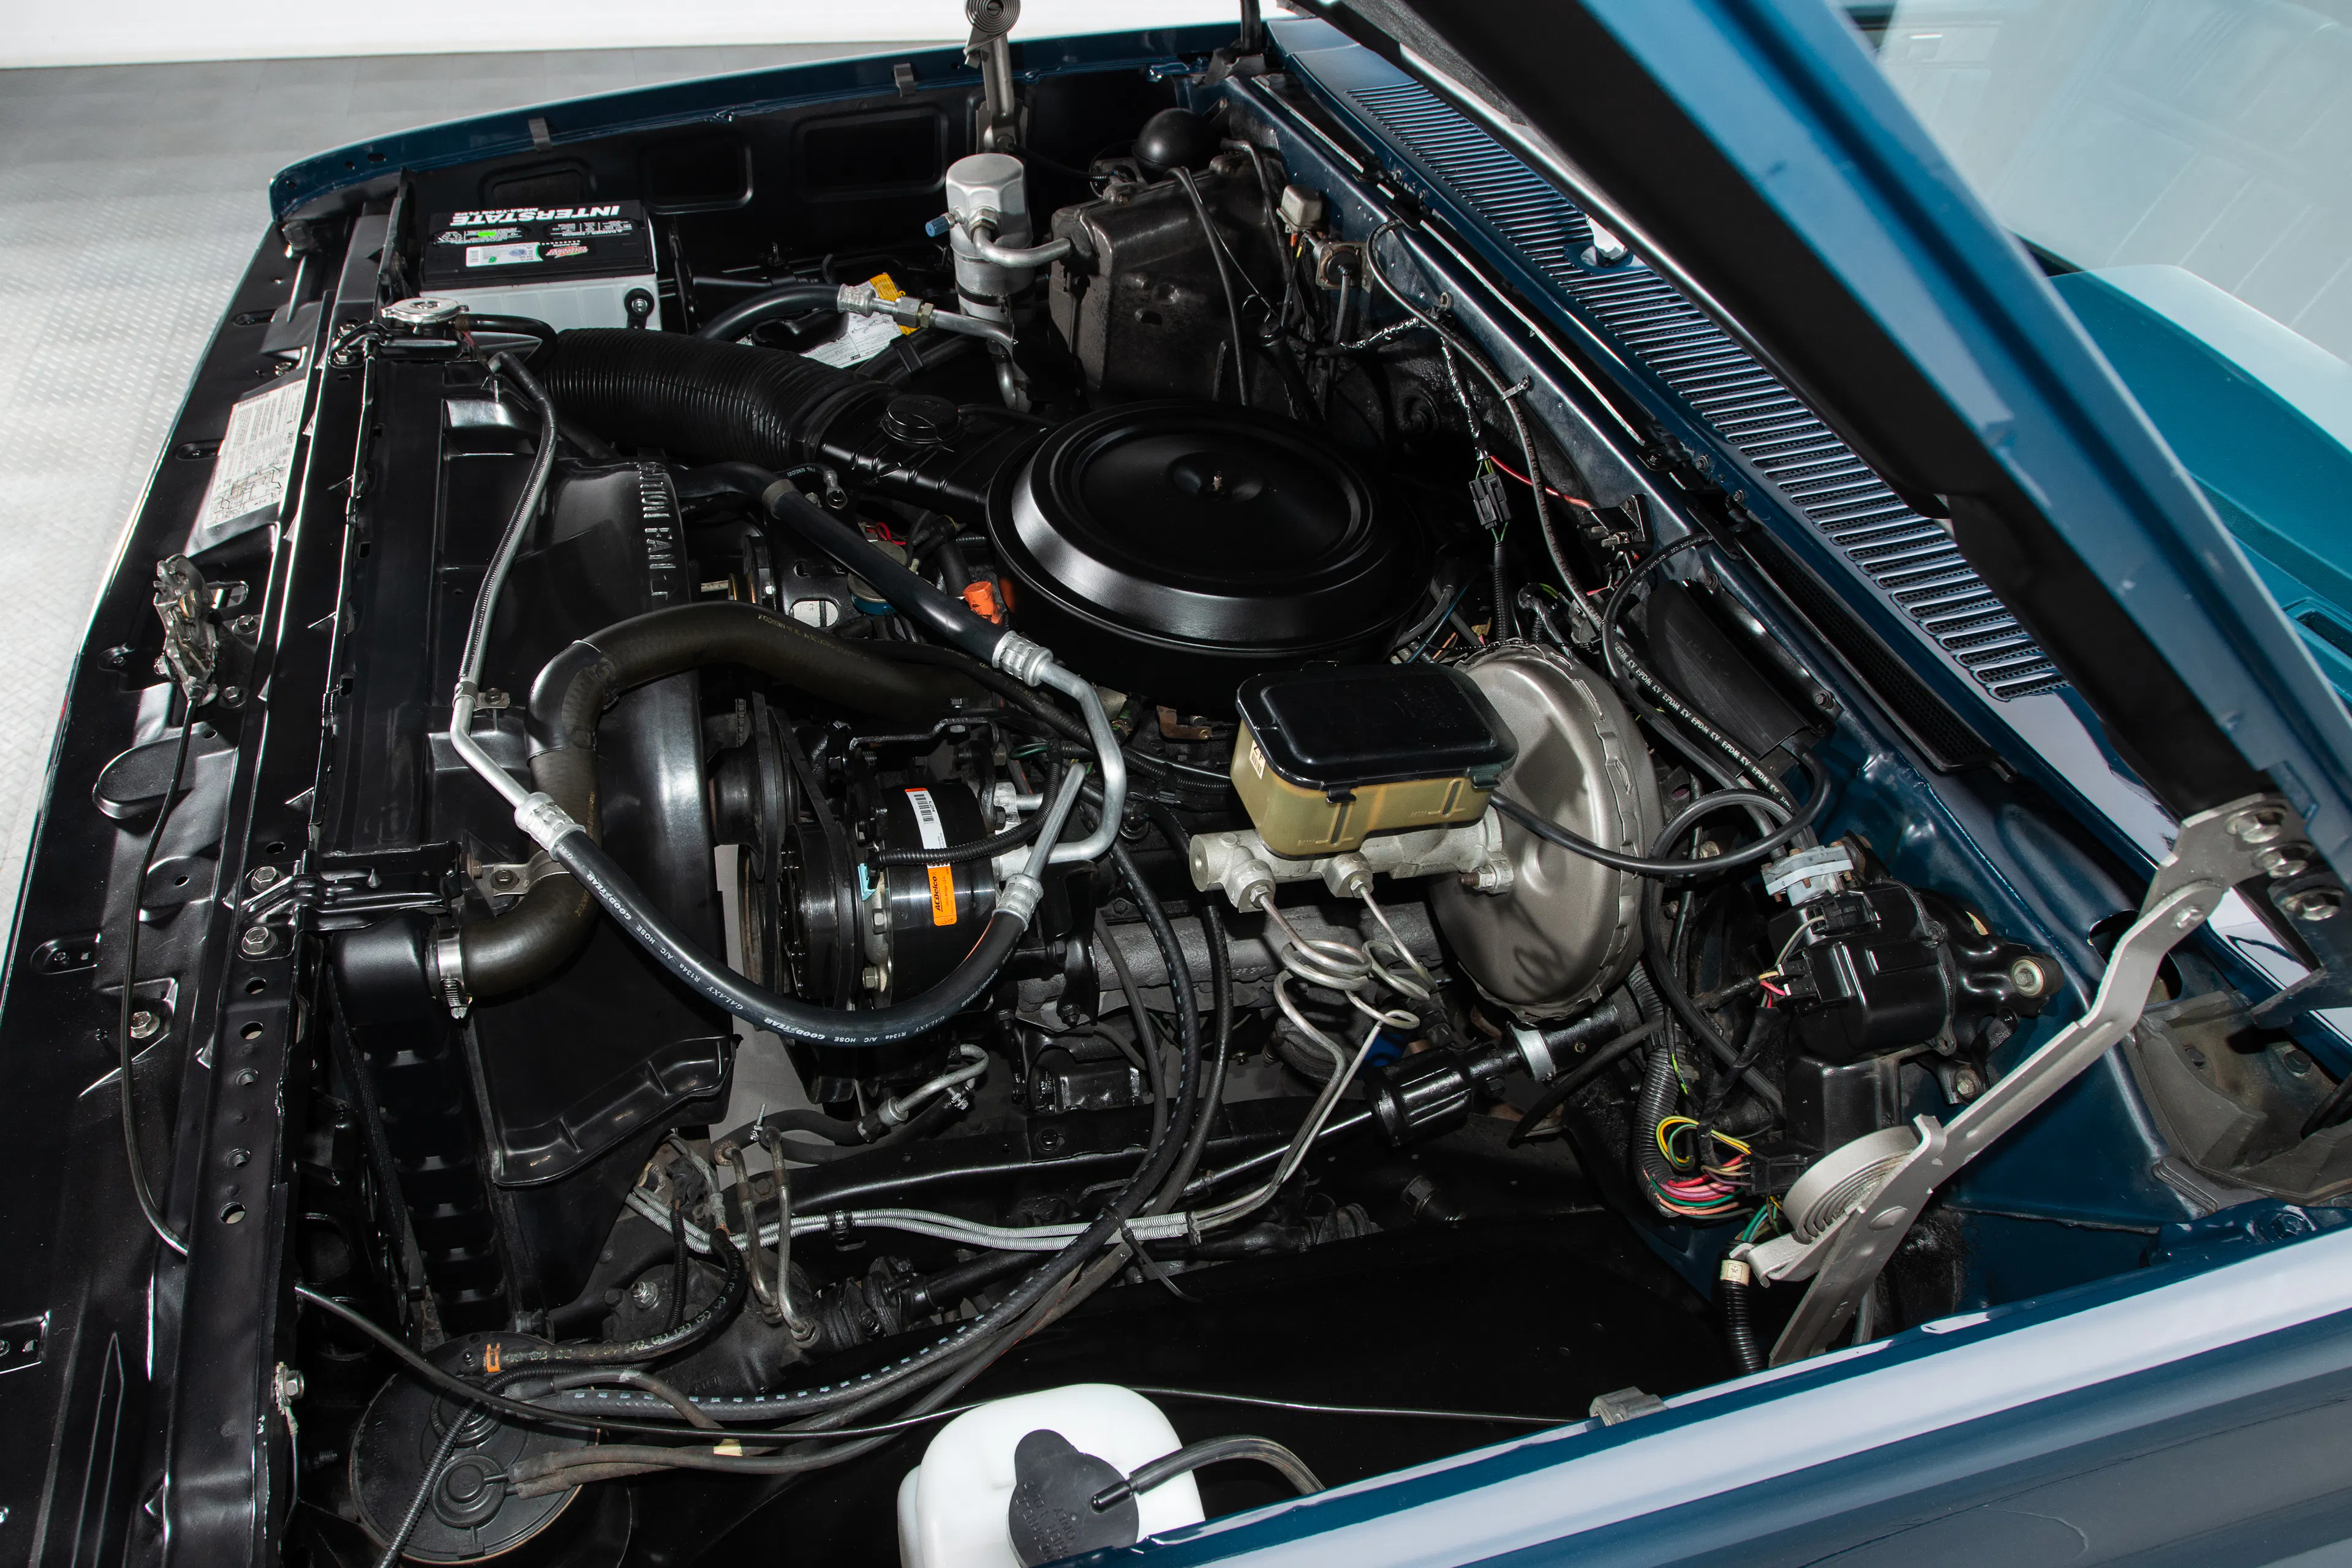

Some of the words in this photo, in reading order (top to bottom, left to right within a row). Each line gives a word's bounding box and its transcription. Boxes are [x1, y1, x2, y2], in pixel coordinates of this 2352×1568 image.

[450, 205, 620, 226] INTERSTATE
[644, 527, 676, 569] FAN
[1615, 642, 1629, 659] EPDM
[1627, 659, 1638, 669] KV
[1635, 668, 1653, 686] EPDM
[1652, 685, 1662, 694] KV
[1662, 693, 1680, 710] EPDM
[1681, 708, 1692, 718] KV
[1691, 717, 1710, 734] EPDM
[1709, 731, 1721, 742] KV
[1721, 741, 1741, 760] EPDM
[1740, 756, 1751, 766] KV
[1751, 766, 1771, 786] EPDM
[1769, 783, 1780, 796] KV
[586, 873, 632, 921] GOODYEAR
[932, 876, 941, 911] ACDelco
[636, 924, 655, 944] HOSE
[660, 948, 674, 960] A/C
[679, 963, 701, 982] R134a
[706, 986, 744, 1011] GALAXY
[961, 968, 998, 1008] GOODYEAR
[764, 1017, 826, 1040] GOODYEAR
[885, 1031, 907, 1040] R134a
[914, 1016, 945, 1033] GALAXY
[1016, 1494, 1055, 1561] NDSHIELD
[1053, 1507, 1076, 1540] ONLY
[1046, 1524, 1071, 1559] SHER
